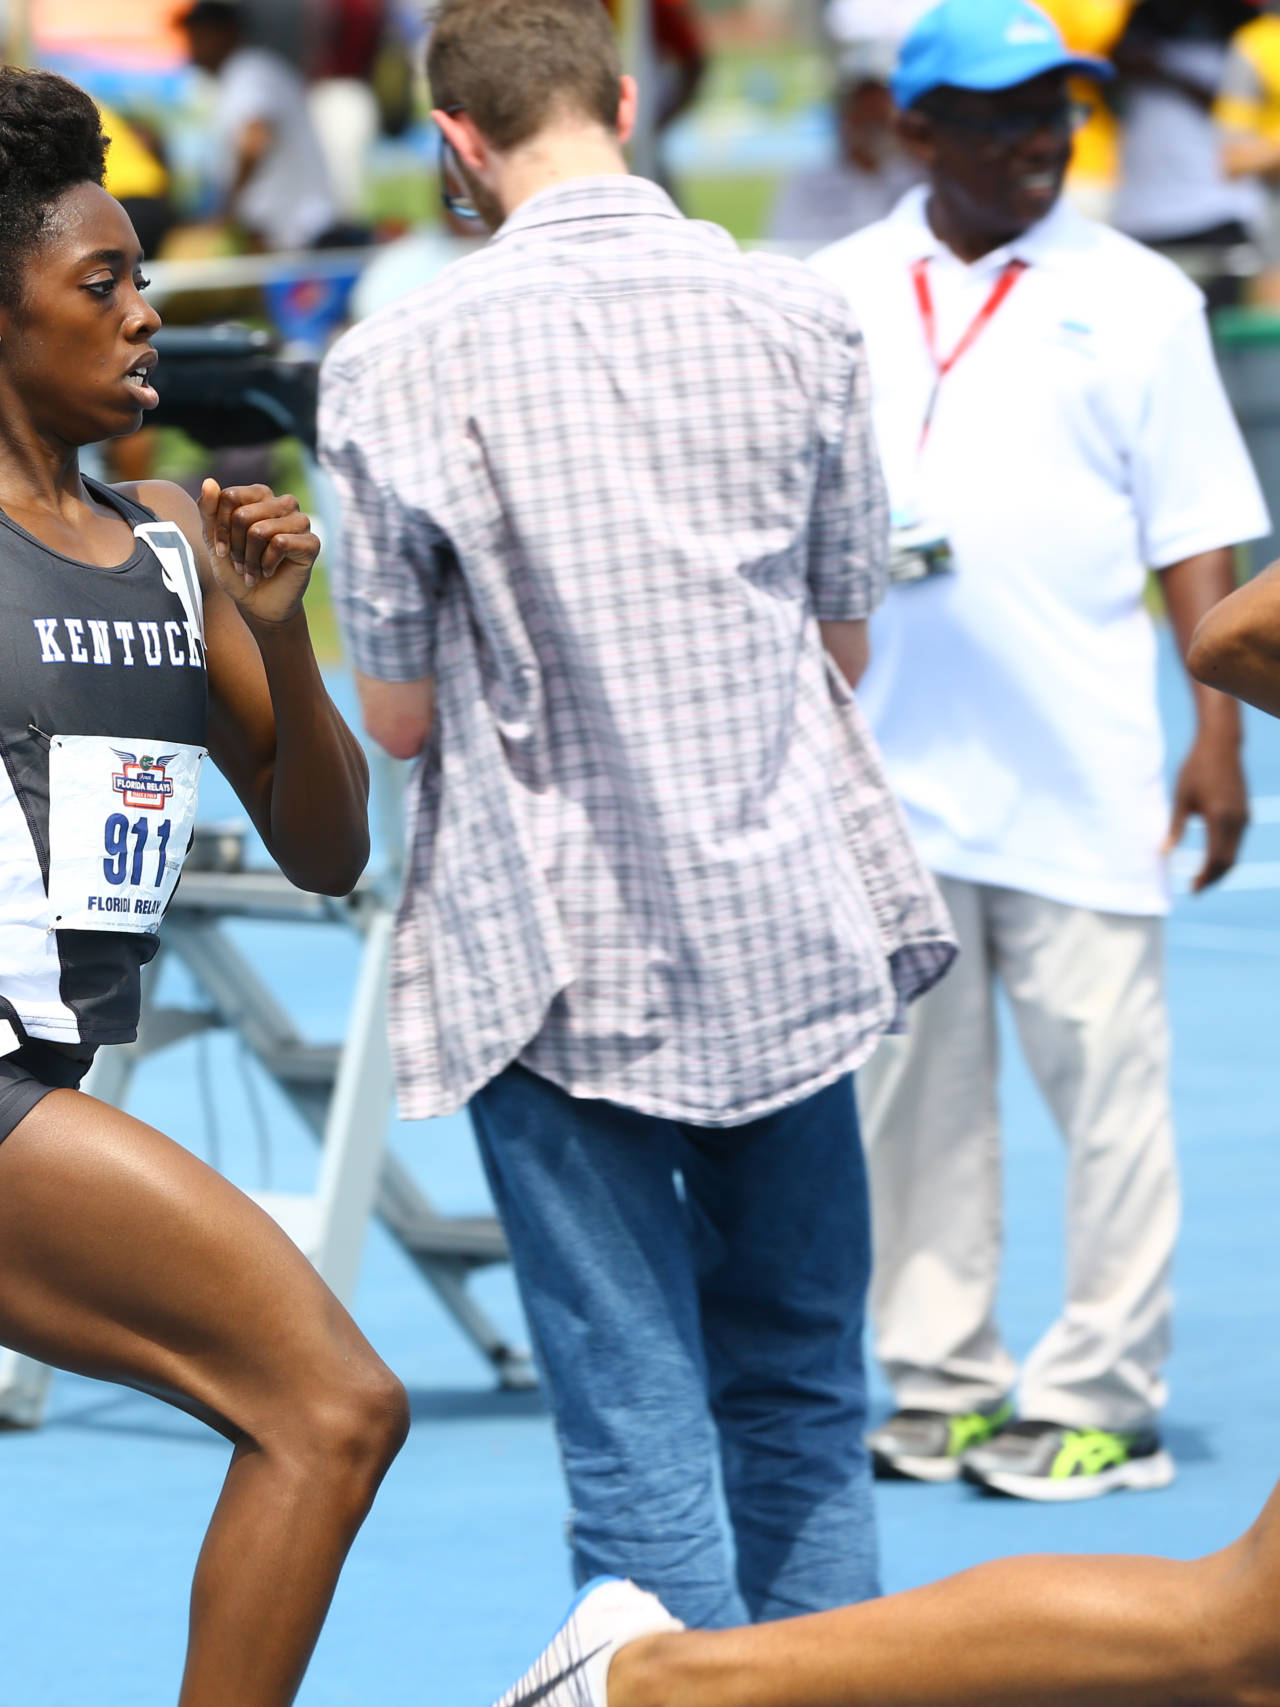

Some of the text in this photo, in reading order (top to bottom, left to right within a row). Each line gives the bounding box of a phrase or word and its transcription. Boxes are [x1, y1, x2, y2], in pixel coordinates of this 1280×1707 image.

[116, 779, 145, 790] FLORIDA
[103, 813, 171, 888] 911
[134, 899, 161, 914] RELAY
